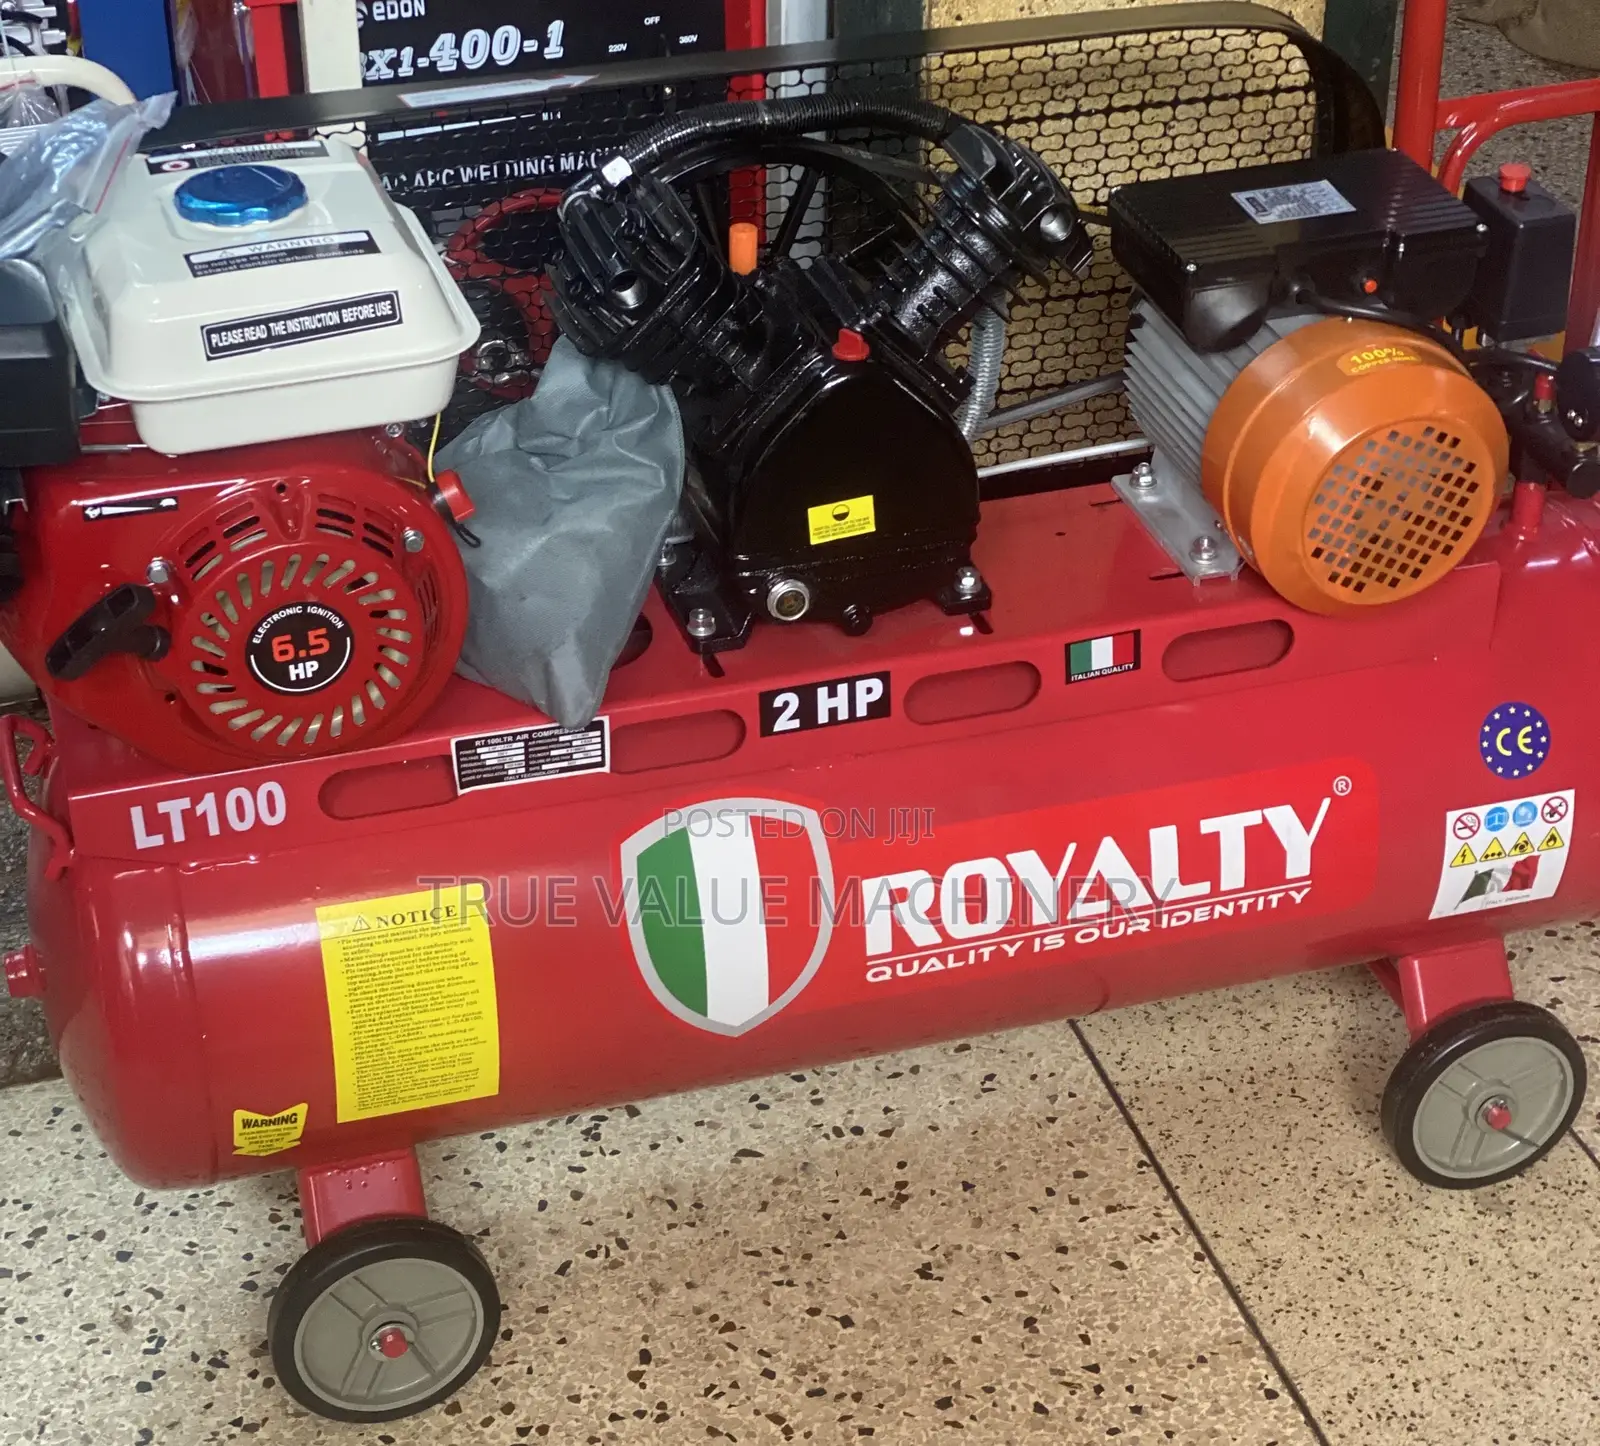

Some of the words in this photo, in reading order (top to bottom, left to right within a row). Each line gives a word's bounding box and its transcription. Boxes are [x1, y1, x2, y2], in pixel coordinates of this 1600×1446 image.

[644, 16, 660, 25] OFF
[608, 43, 627, 53] 220V
[679, 34, 698, 45] 380V
[459, 155, 554, 185] WELDING
[248, 236, 335, 253] WARNING
[240, 259, 277, 270] contain
[279, 254, 314, 264] carbon
[316, 248, 365, 259] monoxide
[261, 252, 287, 260] room
[211, 330, 244, 347] PLEASE
[244, 324, 268, 341] READ
[269, 321, 286, 337] THE
[287, 310, 340, 334] INSTRUCTION
[341, 306, 375, 323] BEFORE
[375, 300, 393, 316] USE
[1350, 347, 1405, 364] 100%
[252, 605, 303, 644] ELECTRONIC
[307, 605, 345, 630] IGNITION
[272, 627, 330, 663] 6.5
[288, 660, 319, 681] HP
[1070, 670, 1100, 682] ITALIAN
[1101, 662, 1134, 676] QUALITY
[772, 691, 800, 732] 2
[817, 677, 884, 725] HP
[475, 739, 486, 747] RT
[487, 735, 514, 745] 100LTR
[516, 733, 529, 741] AIR
[1495, 725, 1534, 757] CE
[130, 781, 286, 850] LT100
[864, 797, 1332, 957] ROYALTY
[376, 904, 458, 929] NOTICE
[865, 939, 1025, 983] QUALITY
[1032, 933, 1066, 953] IS
[1074, 918, 1153, 943] OUR
[1160, 885, 1314, 929] IDENTITY
[242, 1113, 298, 1129] WARNING
